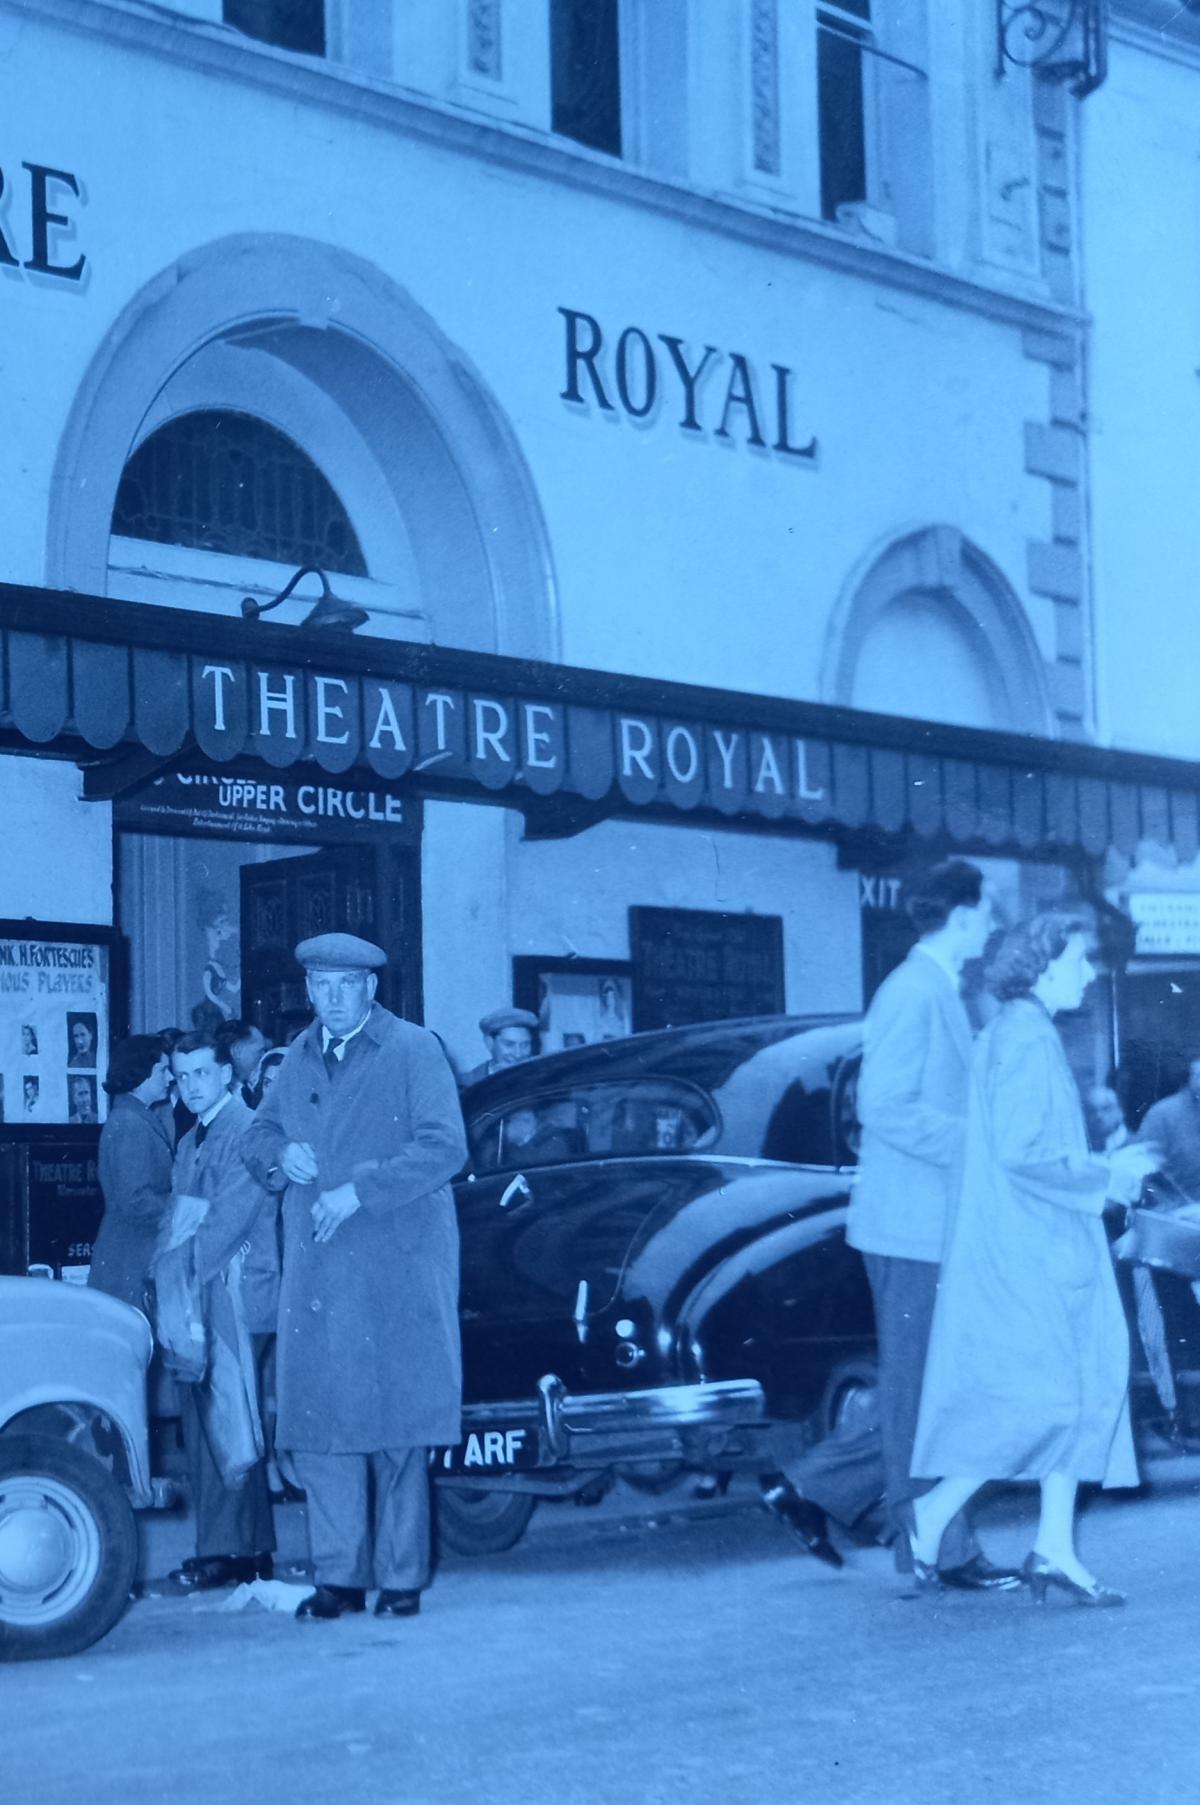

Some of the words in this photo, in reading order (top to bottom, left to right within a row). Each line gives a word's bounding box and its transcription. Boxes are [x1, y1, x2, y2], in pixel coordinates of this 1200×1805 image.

[557, 306, 818, 459] ROYAL
[201, 665, 558, 770] THEATRE
[621, 718, 825, 800] ROYAL
[219, 784, 287, 812] UPPER
[296, 785, 403, 823] CIRCLE
[861, 875, 902, 911] XIT
[463, 1428, 526, 1467] ARF
